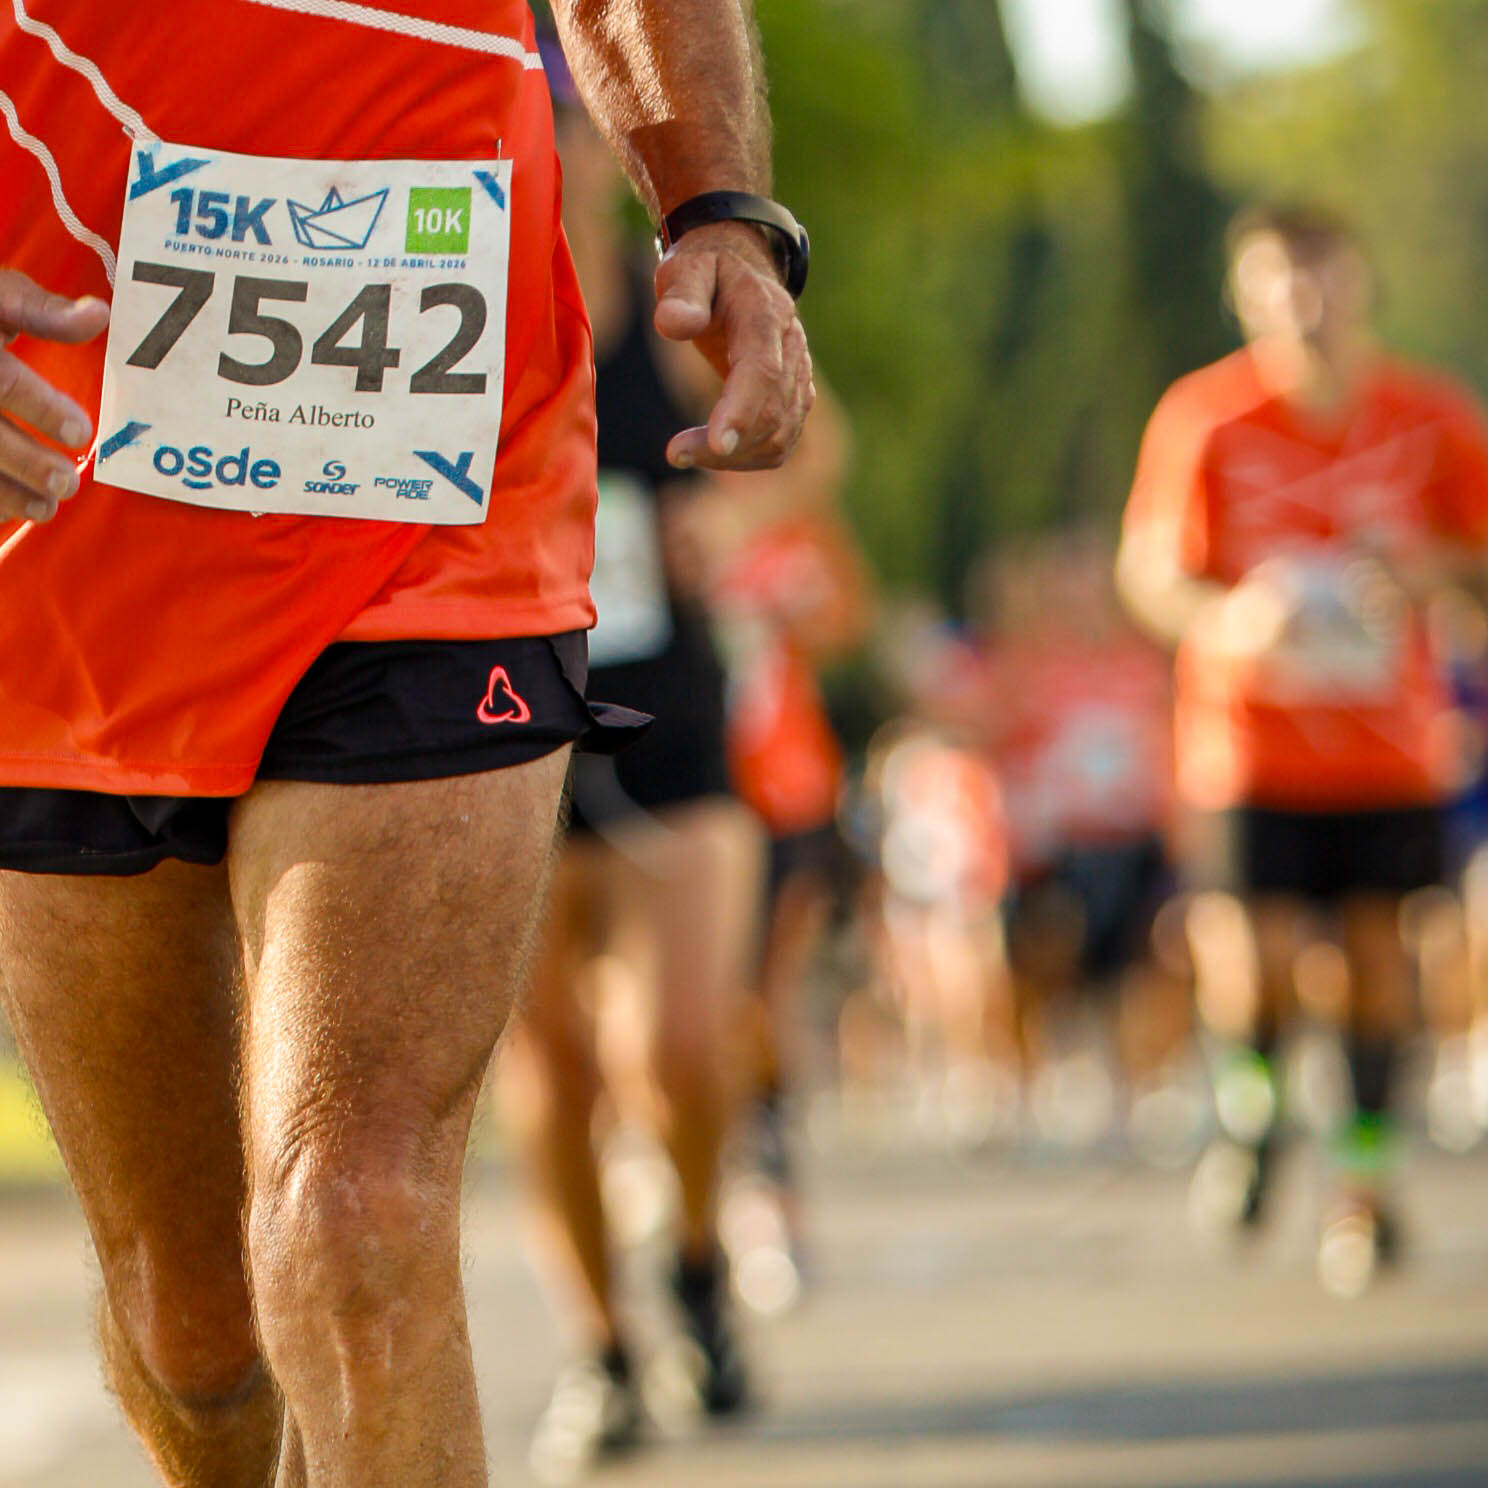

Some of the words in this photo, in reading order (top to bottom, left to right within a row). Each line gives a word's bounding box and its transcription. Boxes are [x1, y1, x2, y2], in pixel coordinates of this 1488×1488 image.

[170, 187, 278, 247] 15K
[414, 208, 464, 234] 10K
[164, 239, 212, 255] PUERTO
[215, 248, 255, 261] NORTE
[303, 256, 355, 269] ROSARIO
[367, 257, 380, 269] 12
[383, 257, 397, 269] DE
[401, 258, 436, 270] ABRIL
[125, 261, 488, 394] 7542
[225, 398, 281, 424] Peña
[288, 404, 376, 430] Alberto
[153, 446, 282, 489] osde
